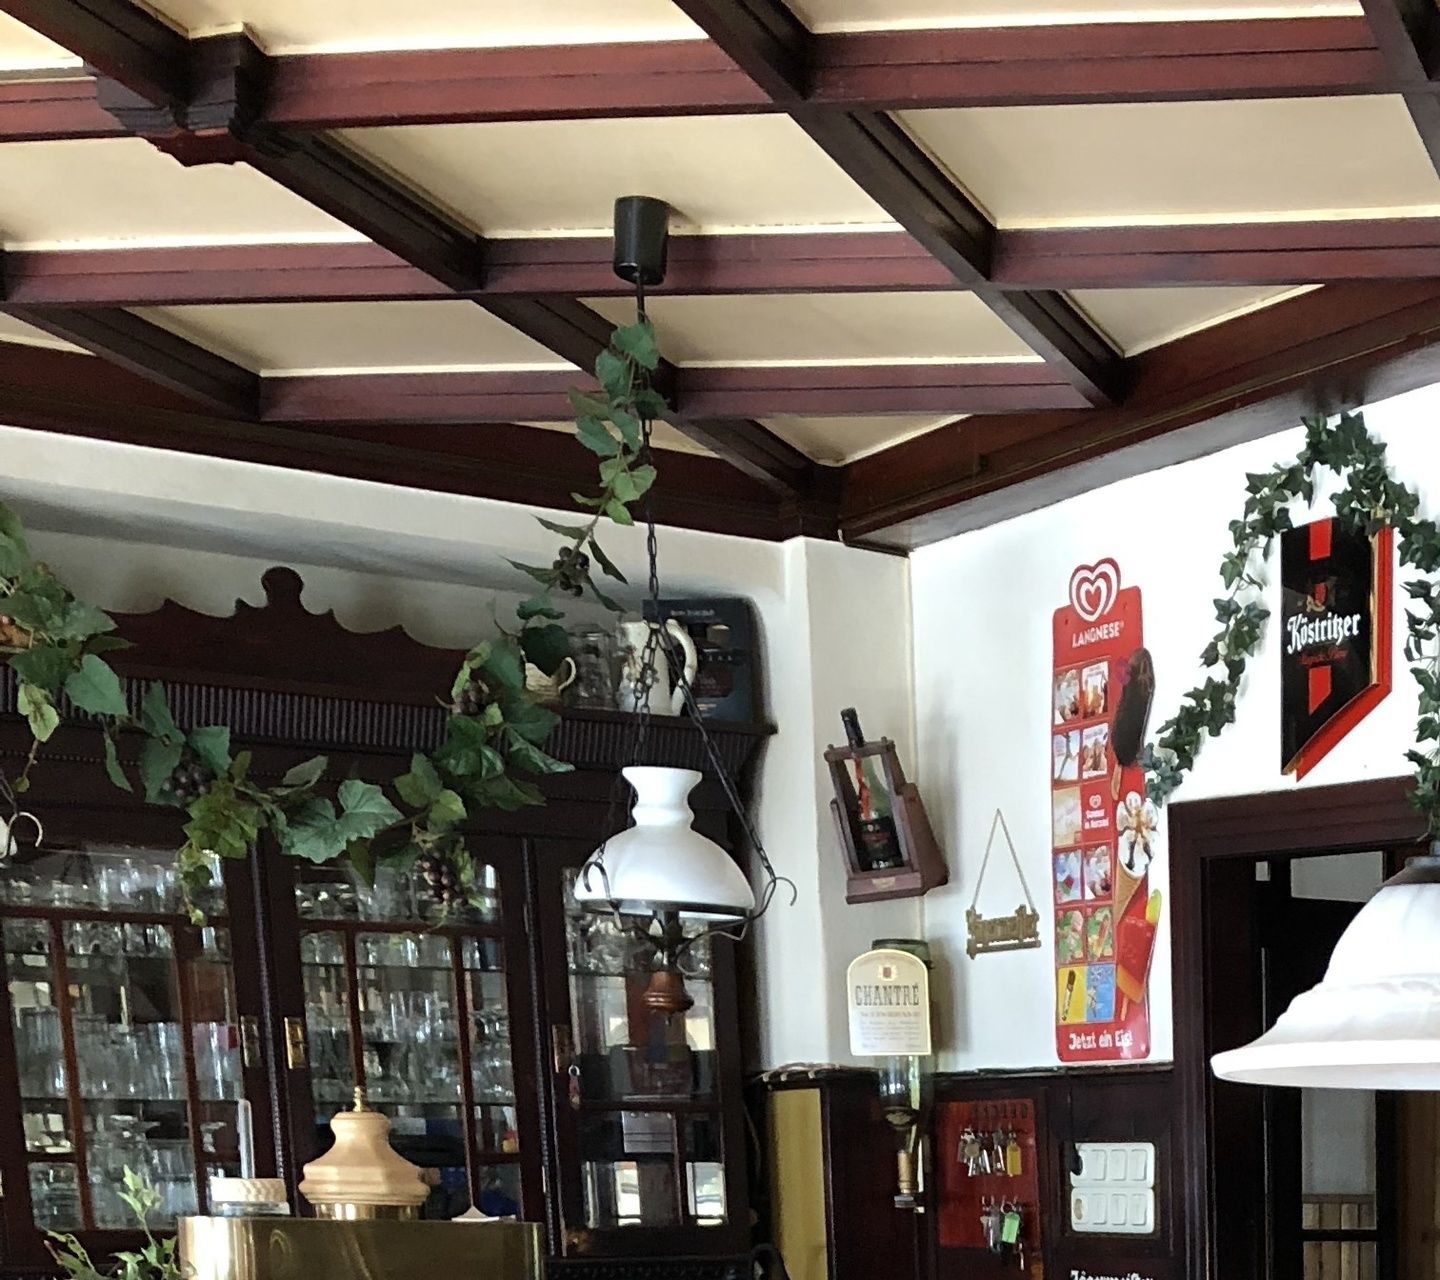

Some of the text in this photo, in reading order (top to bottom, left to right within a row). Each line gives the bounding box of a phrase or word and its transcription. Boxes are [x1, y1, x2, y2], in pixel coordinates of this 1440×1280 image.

[1072, 622, 1121, 648] LANGNESE
[1286, 612, 1361, 654] Köstritzer
[855, 983, 920, 1006] CHANTRÉ
